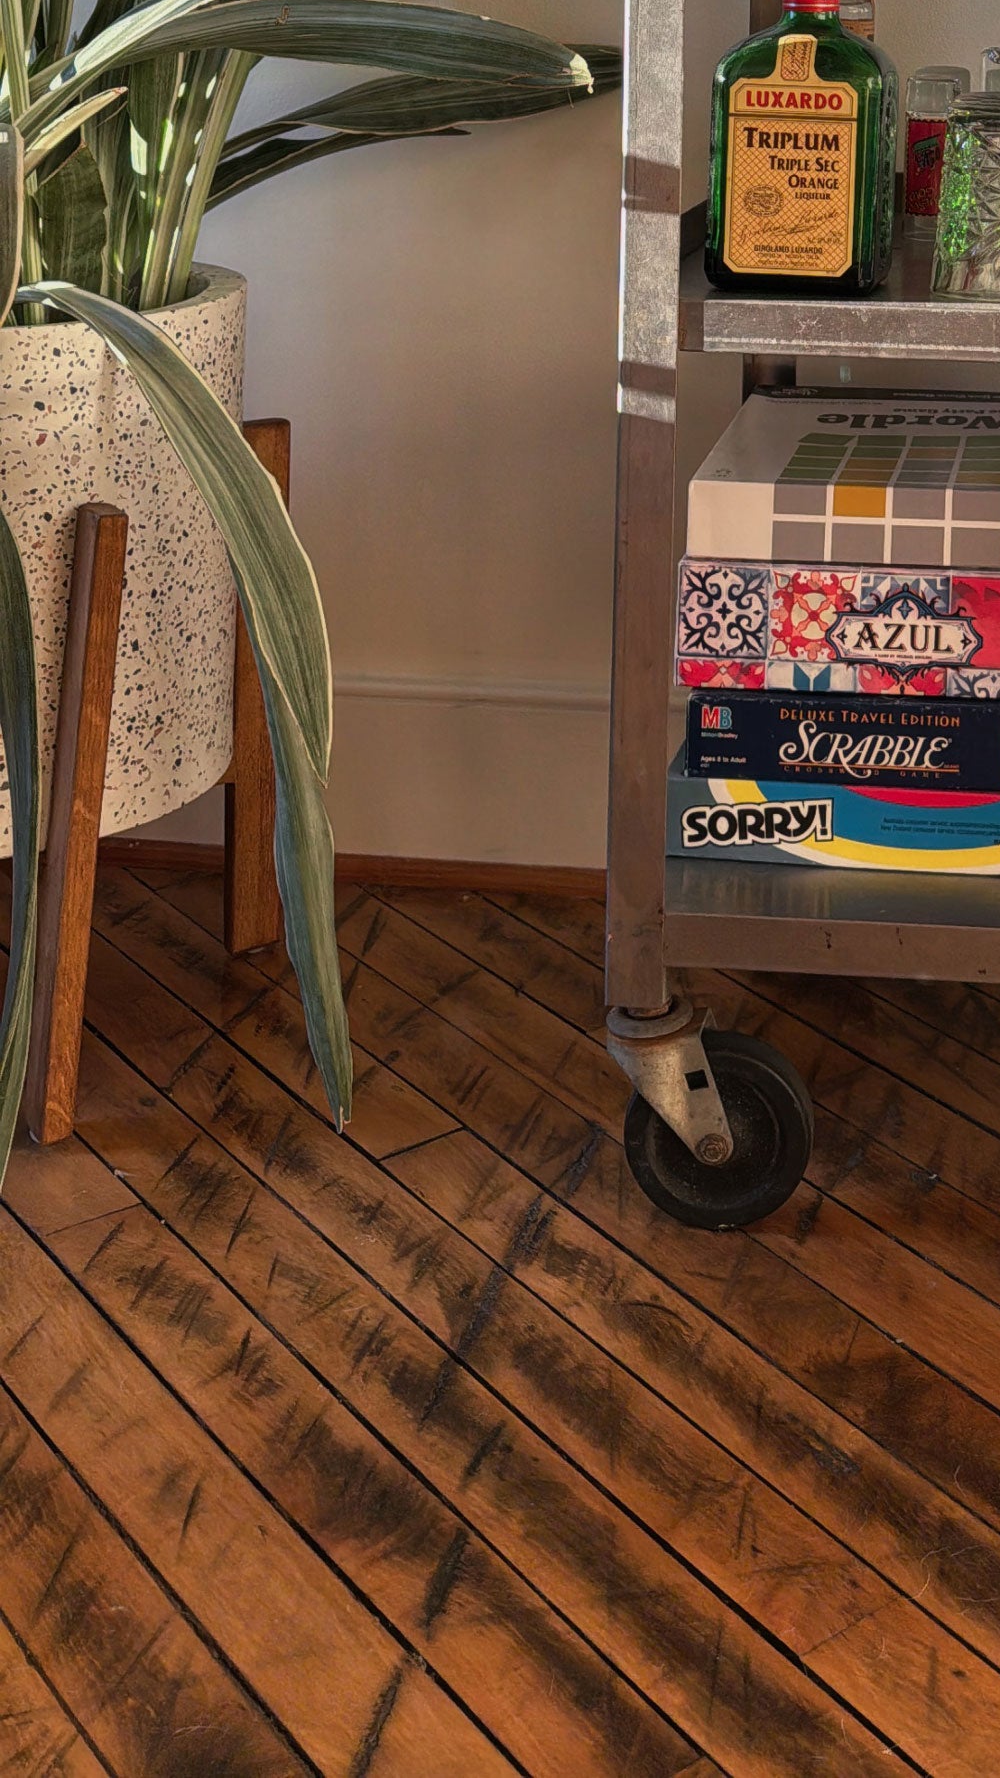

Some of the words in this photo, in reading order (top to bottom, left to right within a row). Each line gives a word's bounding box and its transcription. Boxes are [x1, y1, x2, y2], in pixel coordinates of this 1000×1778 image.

[745, 90, 843, 111] LUXARDO
[743, 126, 840, 152] TRIPLUM
[768, 155, 811, 172] TRIPLE
[814, 157, 840, 173] SEC
[787, 174, 840, 190] ORANGE
[794, 191, 831, 201] LIQUEUR
[791, 246, 823, 255] LUXARDO
[854, 622, 954, 652] AZUL
[701, 704, 732, 730] MB
[779, 707, 835, 722] DELUXE
[841, 709, 895, 725] TRAVEL
[901, 712, 961, 728] EDITION
[700, 755, 716, 763] Ages
[900, 771, 941, 779] GAME
[686, 803, 829, 842] SORRY!
